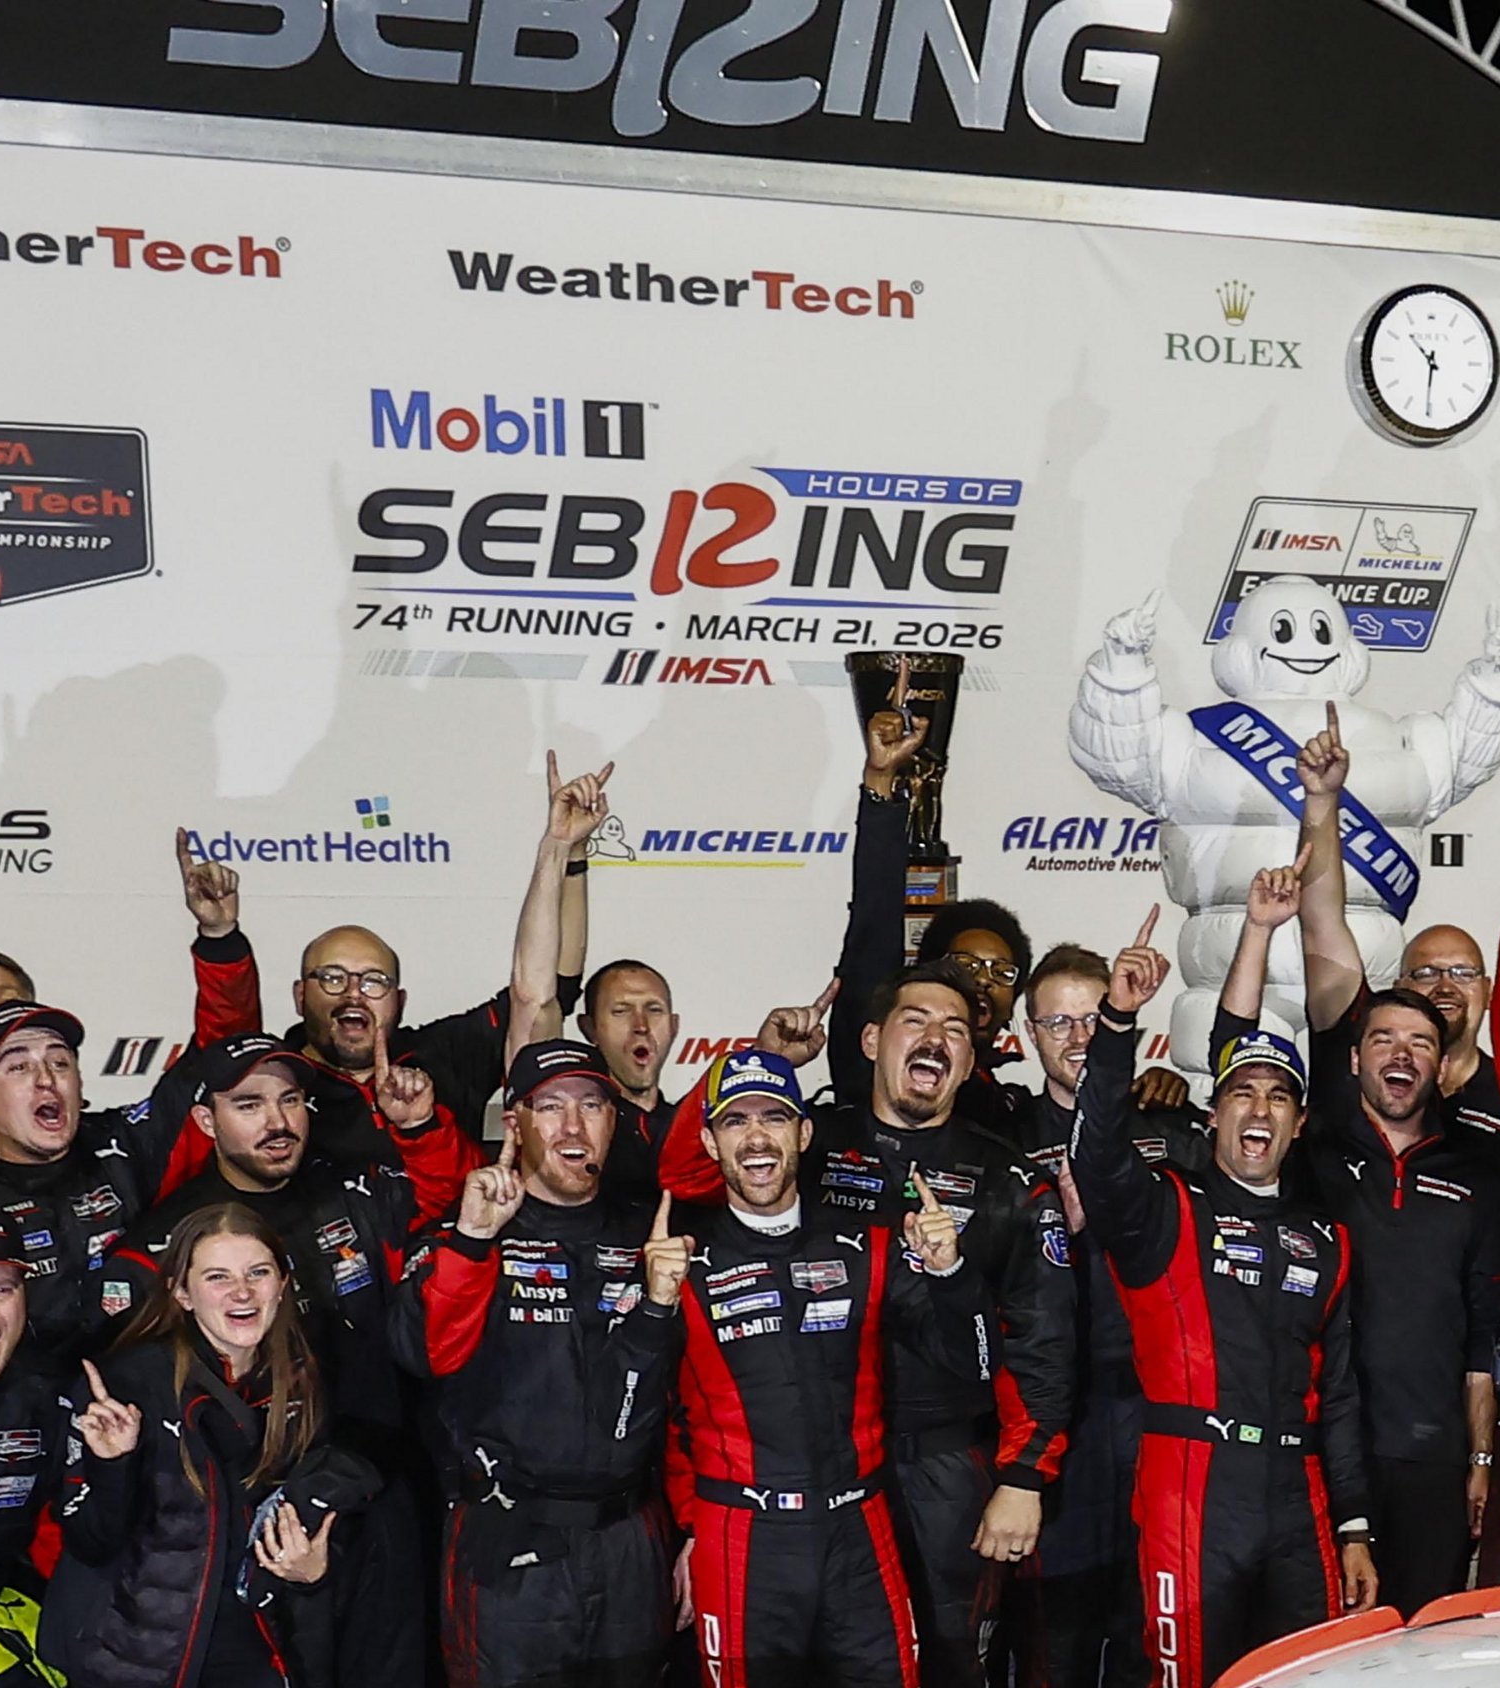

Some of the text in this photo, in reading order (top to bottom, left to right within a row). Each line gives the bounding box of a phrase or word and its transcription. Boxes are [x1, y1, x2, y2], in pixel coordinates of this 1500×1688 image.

[1164, 332, 1303, 370] ROLEX
[370, 388, 640, 459] Mobil 1
[807, 475, 1013, 503] HOURS OF
[1281, 533, 1343, 552] IMSA
[1358, 557, 1443, 572] MICHELIN
[1239, 576, 1378, 605] EANCE
[353, 603, 433, 632] 74th
[446, 608, 633, 640] RUNNING
[686, 615, 820, 645] MARCH
[892, 622, 1004, 650] 2026
[658, 656, 774, 687] IMSA
[1219, 712, 1416, 898] MICELIN
[640, 829, 848, 854] MICHELIN
[1002, 815, 1158, 858] ALAN JA
[1026, 855, 1163, 873] Automotive Netw
[821, 1189, 876, 1212] Ansys
[511, 1281, 568, 1303] Ansys
[973, 1313, 991, 1381] PORSCHE
[614, 1369, 640, 1441] ORSCHE
